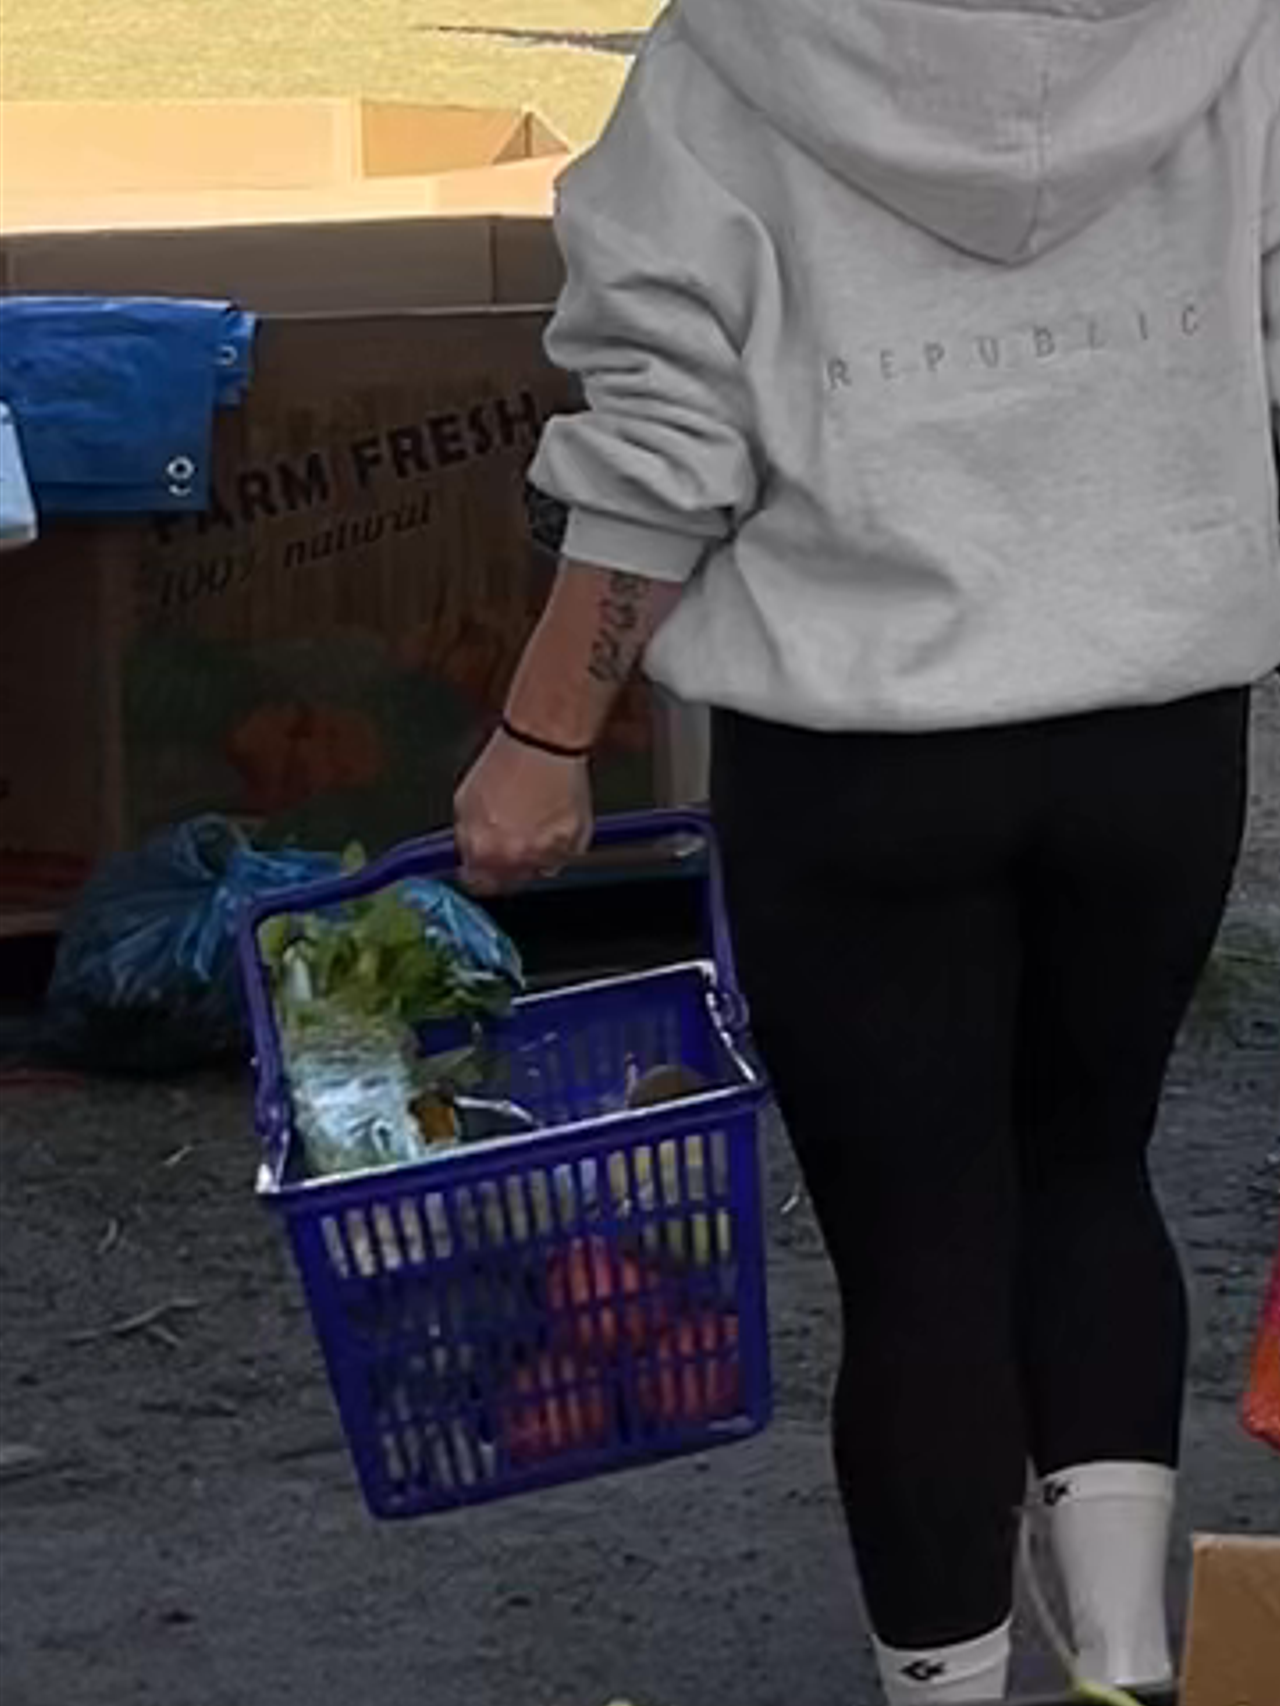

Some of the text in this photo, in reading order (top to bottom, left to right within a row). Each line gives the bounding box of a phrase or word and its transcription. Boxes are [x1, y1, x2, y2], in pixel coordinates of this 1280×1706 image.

[826, 304, 1199, 390] REPUBLIC
[351, 390, 540, 489] FRESH
[283, 492, 433, 569] natural
